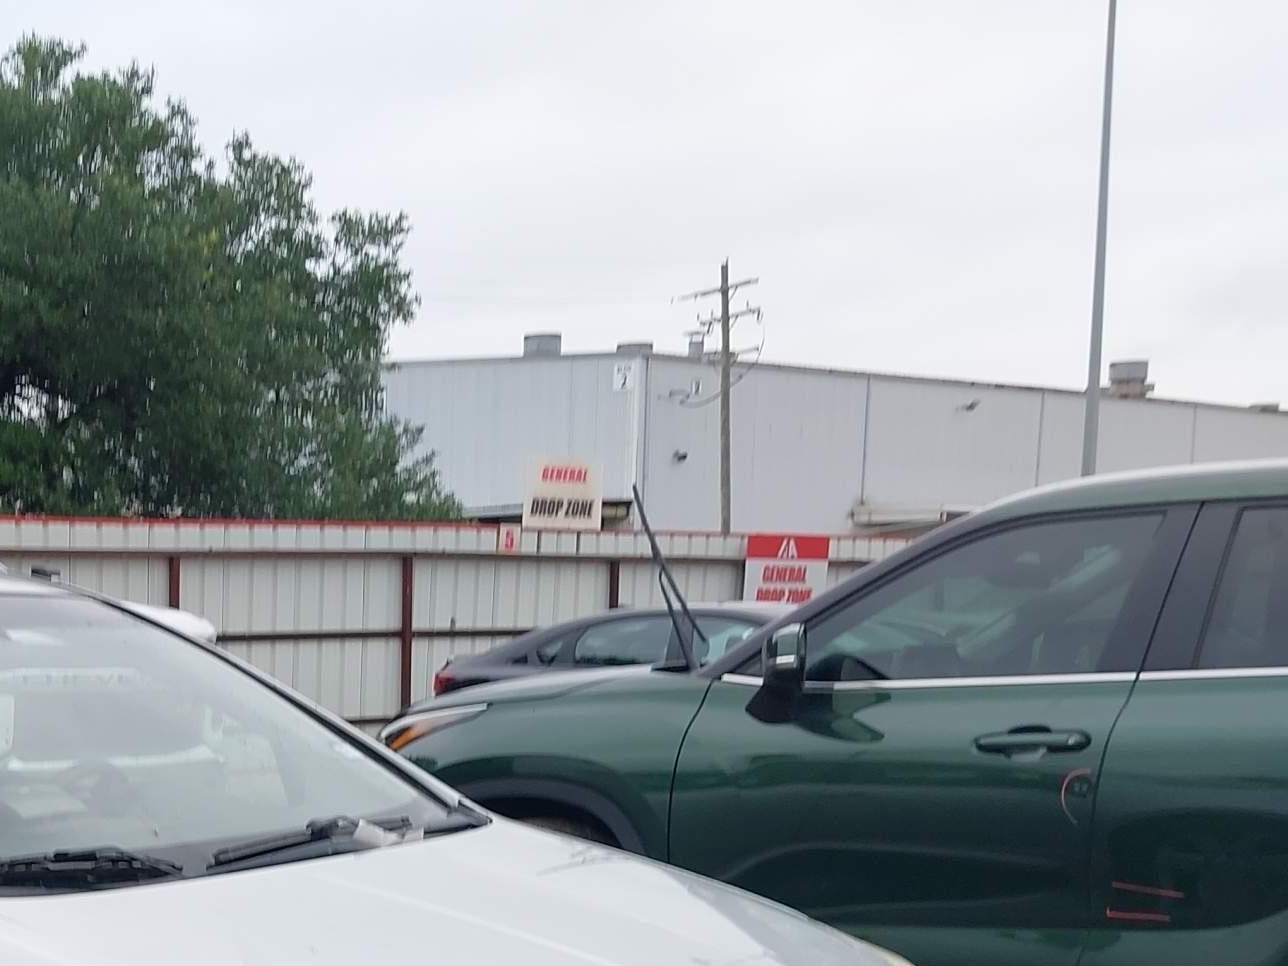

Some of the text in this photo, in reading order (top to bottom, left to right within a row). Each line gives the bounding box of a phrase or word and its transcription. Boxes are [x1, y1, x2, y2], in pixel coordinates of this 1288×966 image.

[541, 466, 587, 482] GENERAL
[530, 498, 594, 518] DROP ZONE
[762, 565, 807, 583] GENERAL
